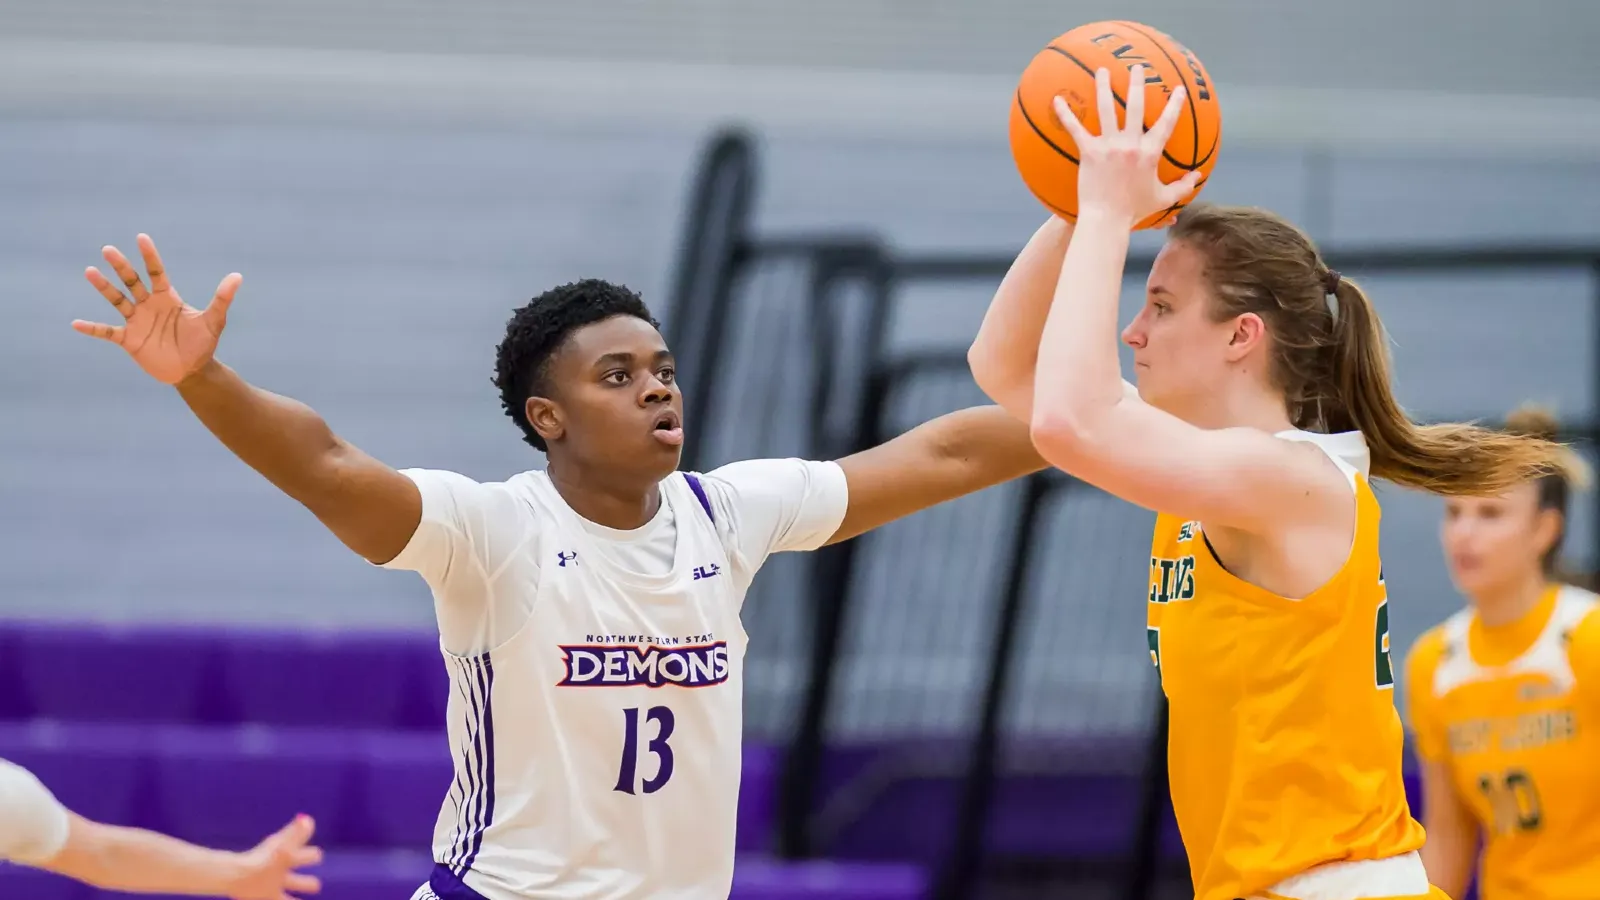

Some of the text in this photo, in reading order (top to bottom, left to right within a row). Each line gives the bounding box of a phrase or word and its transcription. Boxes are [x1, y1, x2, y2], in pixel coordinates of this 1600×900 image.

[569, 646, 728, 684] DEMONS
[612, 705, 675, 796] 13
[1478, 768, 1544, 837] 10
